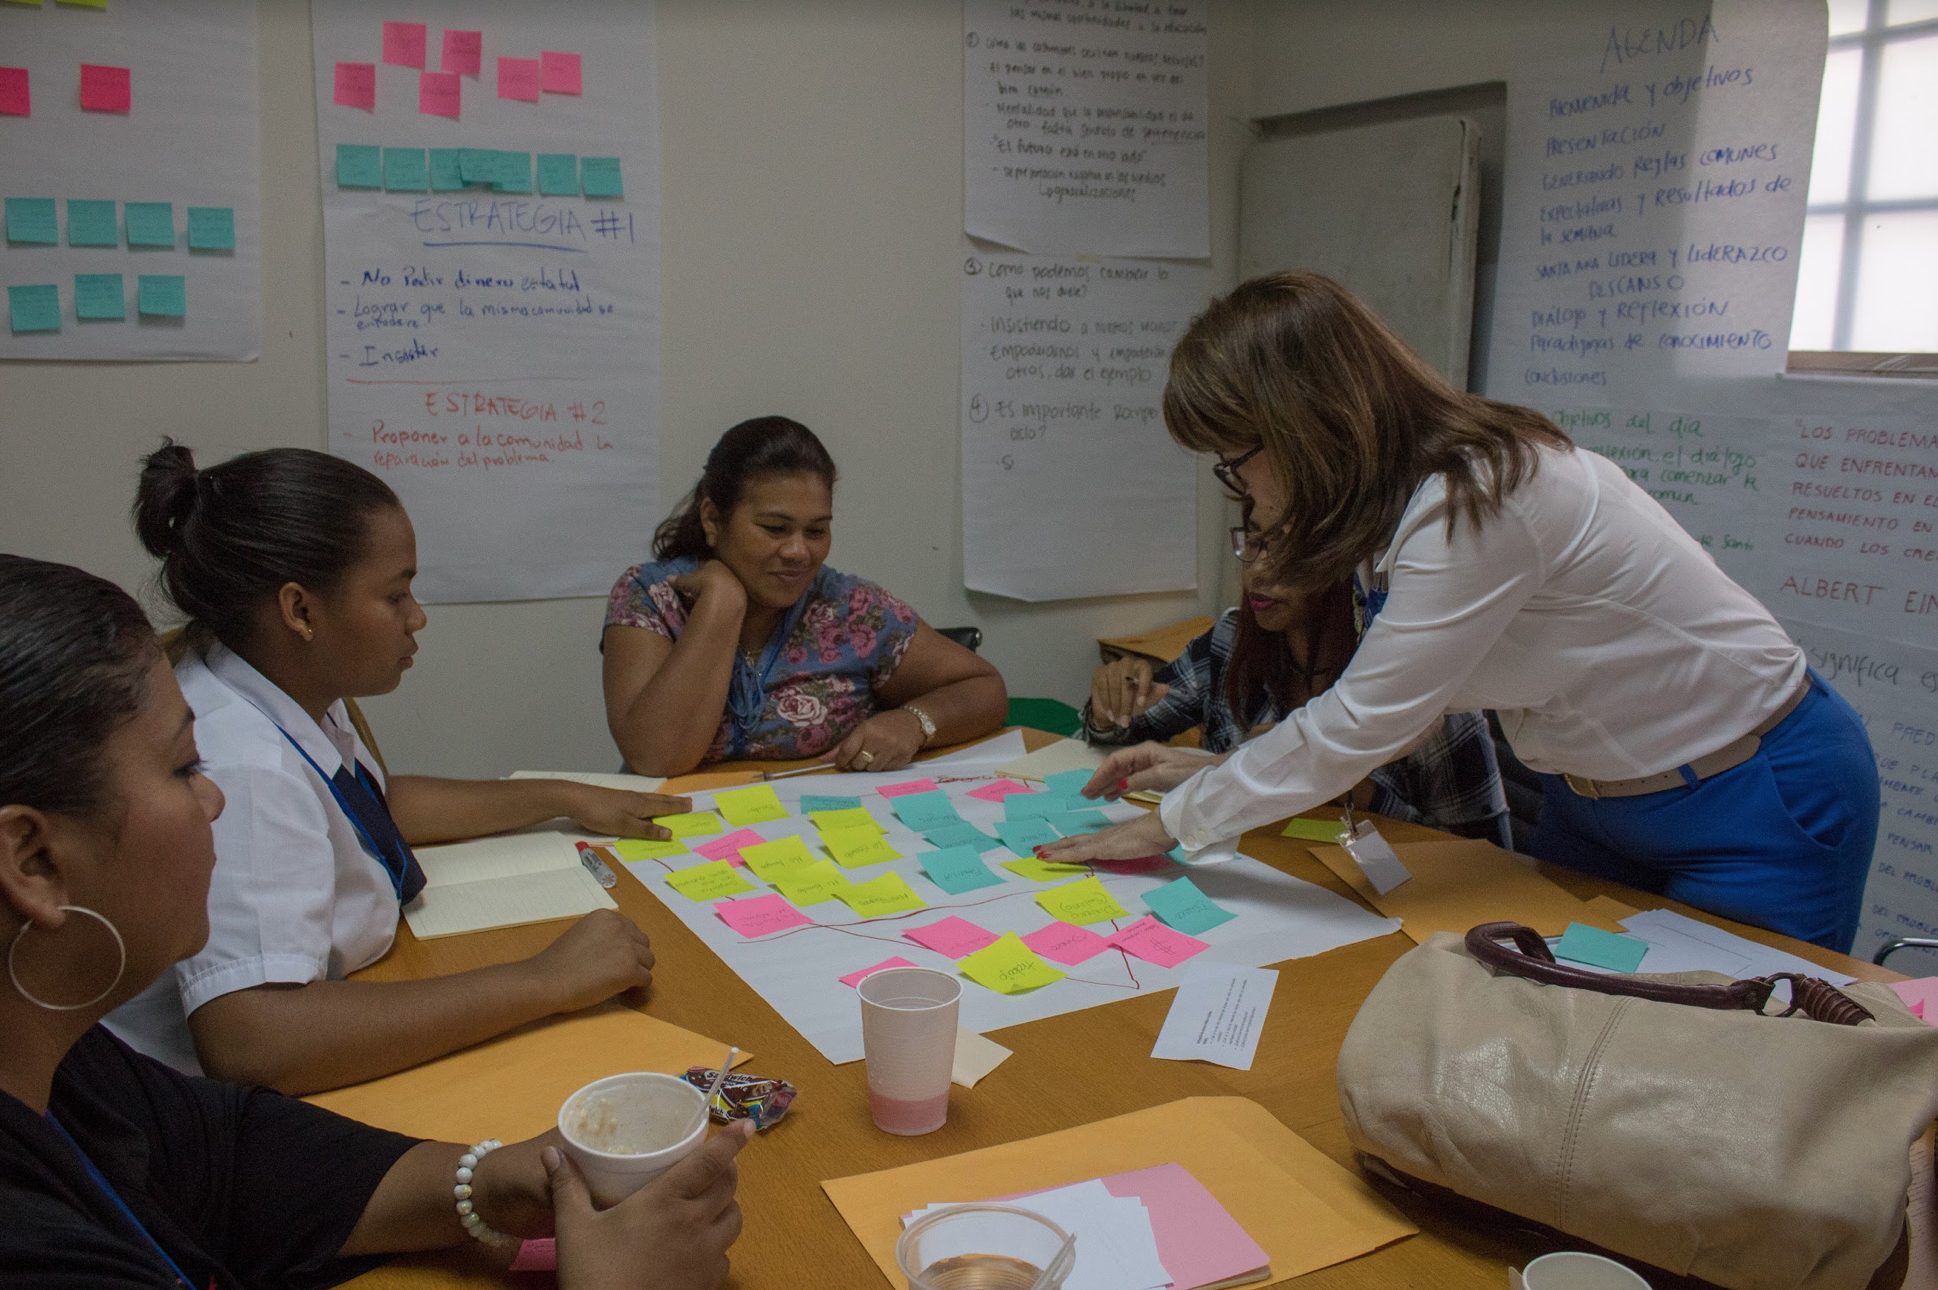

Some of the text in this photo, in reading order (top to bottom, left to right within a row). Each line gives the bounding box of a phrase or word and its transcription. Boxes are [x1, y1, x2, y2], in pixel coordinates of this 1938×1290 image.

[1600, 14, 1720, 73] AGENDA
[1764, 174, 1792, 194] de
[411, 197, 634, 243] ESTRATEGIA #1
[361, 268, 391, 287] No
[455, 269, 514, 289] dinero
[521, 267, 580, 292] estatal
[353, 296, 409, 320] Lograr
[420, 302, 446, 324] que
[460, 298, 475, 317] la
[425, 392, 608, 426] ESTRATEGIA #2
[371, 419, 448, 447] Proponer
[458, 435, 469, 446] a
[476, 425, 493, 449] la
[496, 430, 584, 451] comunidad
[1626, 411, 1656, 435] del
[1794, 452, 1829, 470] QUE
[1791, 481, 1883, 503] RESUELTOS
[1893, 491, 1916, 505] EN
[1788, 507, 1932, 533] PENSAMIENTO EN
[1784, 532, 1845, 549] CUANDO
[1860, 542, 1890, 556] LOS
[1780, 575, 1885, 606] ALBERT
